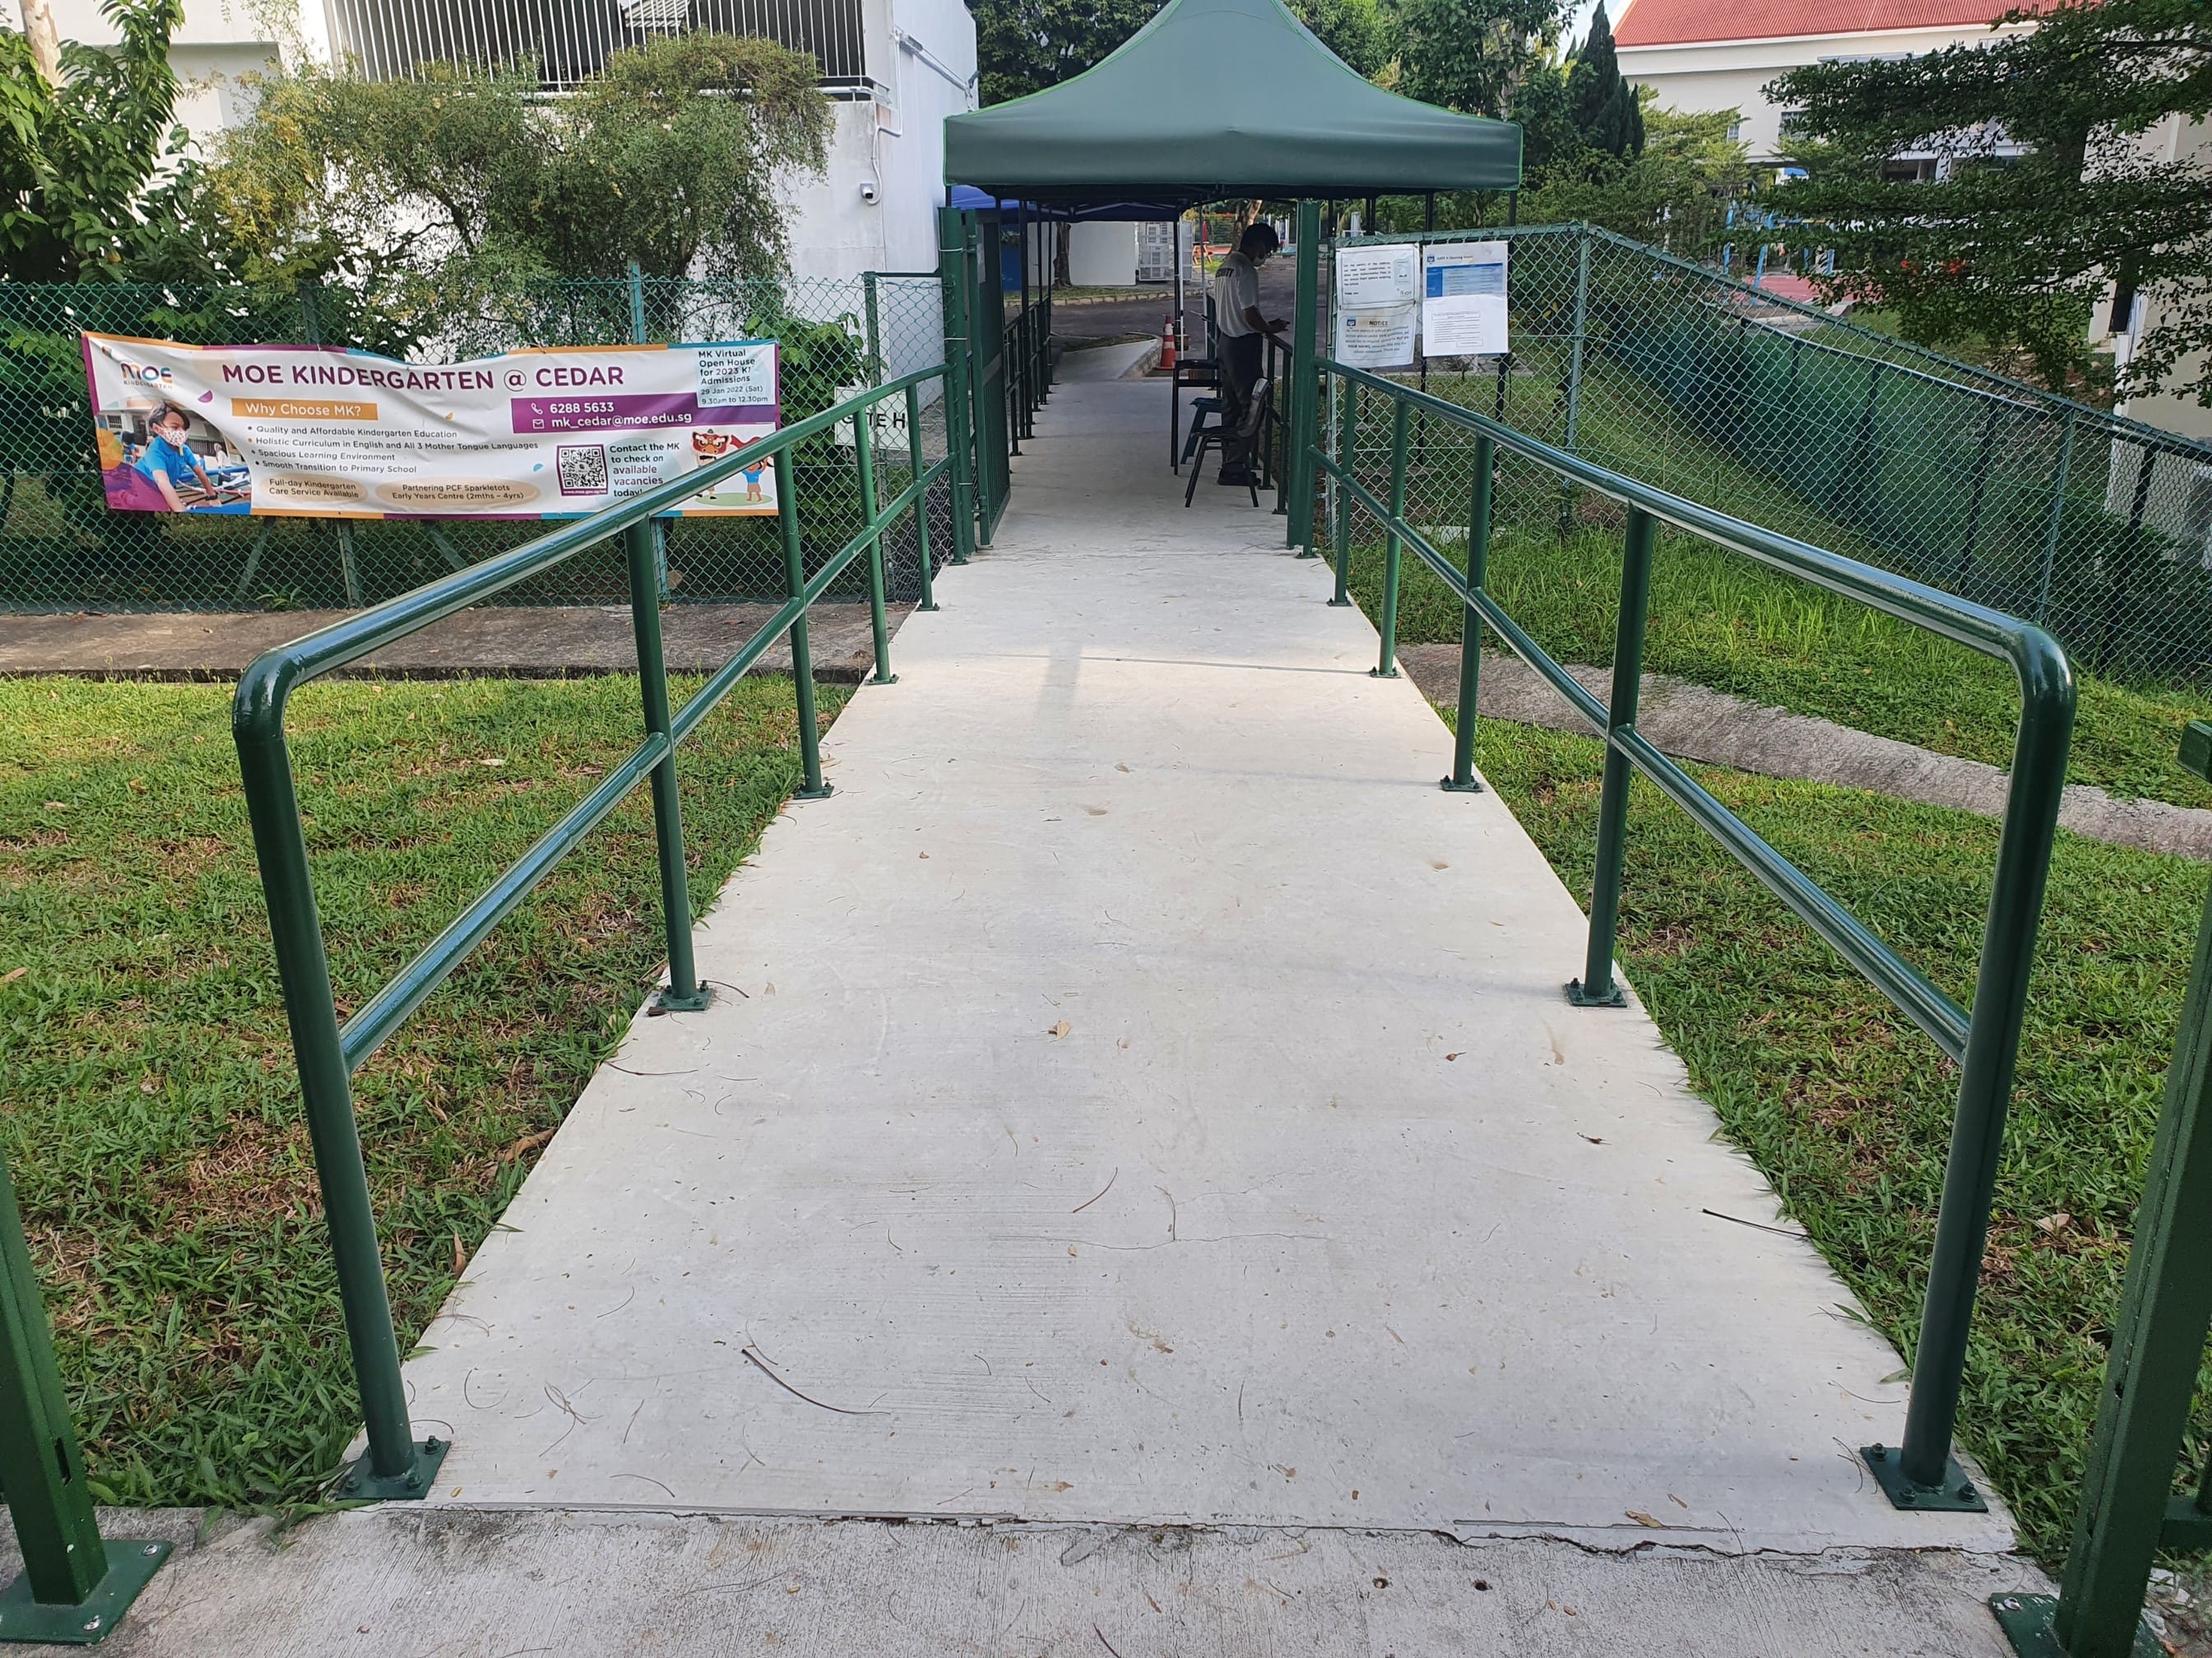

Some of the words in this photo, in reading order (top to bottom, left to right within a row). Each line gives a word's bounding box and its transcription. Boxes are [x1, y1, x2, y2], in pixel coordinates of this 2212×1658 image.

[715, 349, 746, 358] Virtual
[699, 360, 724, 368] Open
[222, 364, 284, 383] MOE
[292, 365, 494, 390] KINDERGARTEN
[503, 369, 526, 392] @
[536, 366, 624, 387] CEDAR
[701, 376, 750, 385] Admissions
[245, 402, 276, 415] Why
[281, 403, 330, 416] Choose
[334, 405, 361, 416] MK?
[550, 403, 581, 414] 6288
[584, 401, 614, 413] 5633
[552, 413, 693, 428] mk_cedar@moe.edu.sg
[842, 413, 886, 428] GTE
[893, 412, 906, 428] H
[257, 425, 288, 434] Quality
[358, 428, 411, 438] Kindergarten
[415, 430, 457, 438] Education
[256, 438, 290, 446] Holistic
[292, 438, 340, 447] Curriculum
[353, 441, 383, 450] English
[492, 442, 539, 451] Languages
[610, 444, 647, 453] Contact
[649, 443, 664, 452] the
[666, 442, 679, 451] MK
[258, 449, 296, 458] Spacious
[299, 452, 338, 461] Learning
[341, 452, 395, 461] Environment
[262, 461, 293, 469] Smooth
[296, 463, 336, 471] Transition
[351, 465, 384, 474] Primary
[613, 465, 657, 475] available
[269, 479, 302, 488] Full-day
[304, 480, 356, 490] Kindergarten
[614, 476, 663, 485] vacancies
[323, 490, 359, 498] Available
[402, 484, 443, 493] Partnering
[464, 484, 510, 493] Sparkletots
[392, 493, 412, 501] Early
[466, 493, 494, 501] (2mths
[503, 493, 524, 501] 4yrs)
